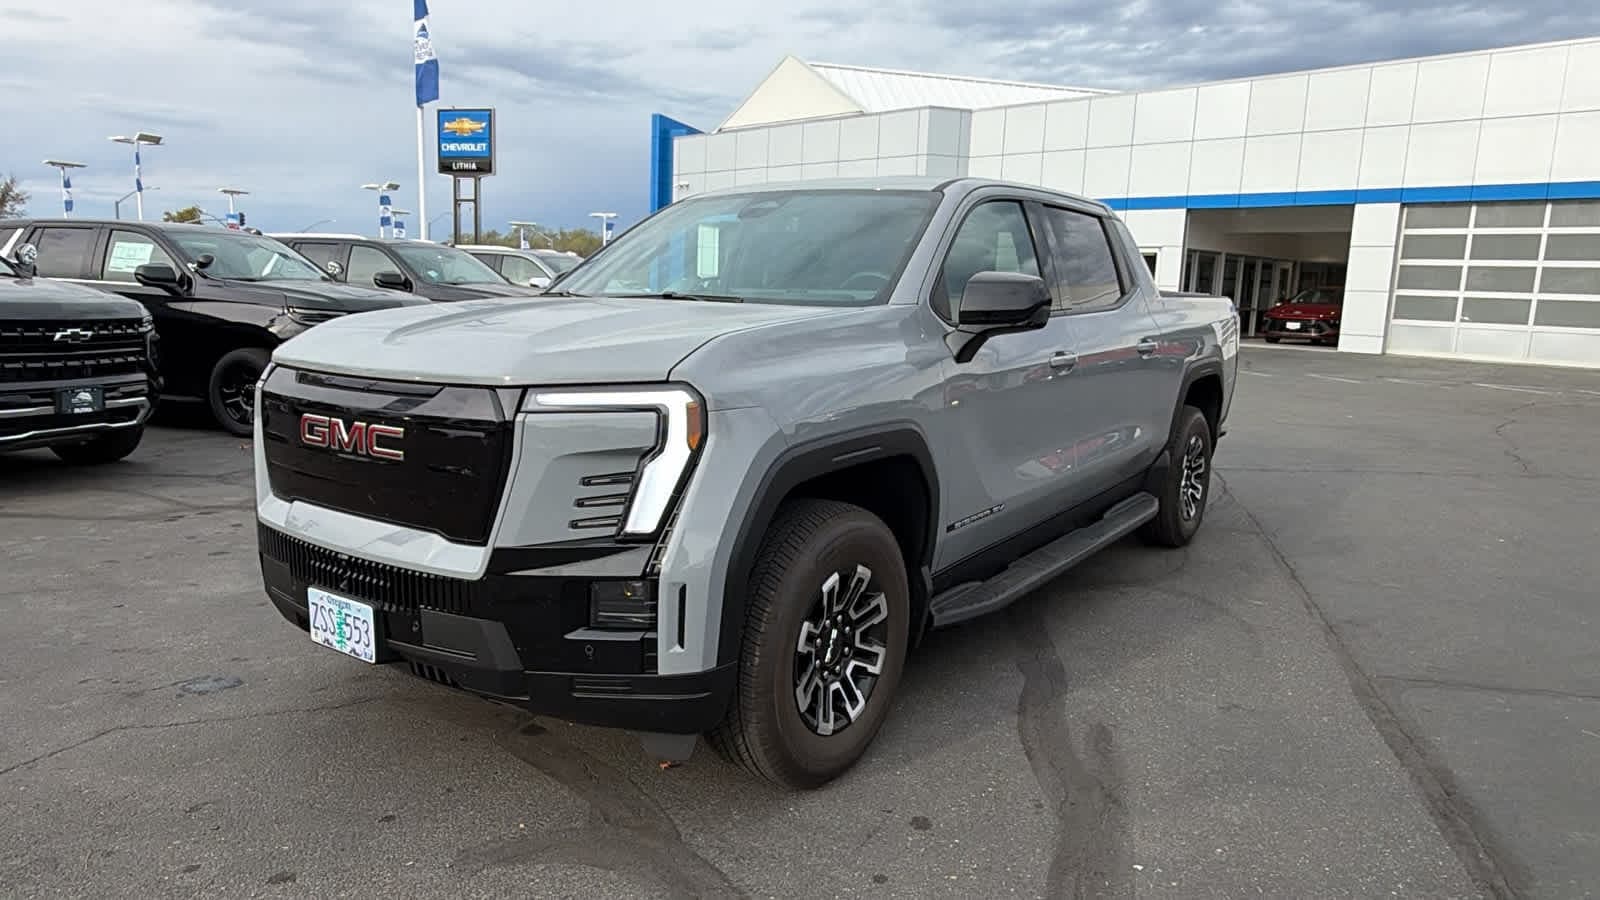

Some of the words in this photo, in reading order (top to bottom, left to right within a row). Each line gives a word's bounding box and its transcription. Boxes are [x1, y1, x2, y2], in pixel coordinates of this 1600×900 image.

[441, 143, 487, 152] CHEVROLET
[452, 162, 477, 170] LITHIA
[300, 413, 404, 461] GMC
[311, 602, 337, 635] ZSS
[344, 613, 370, 648] 553
